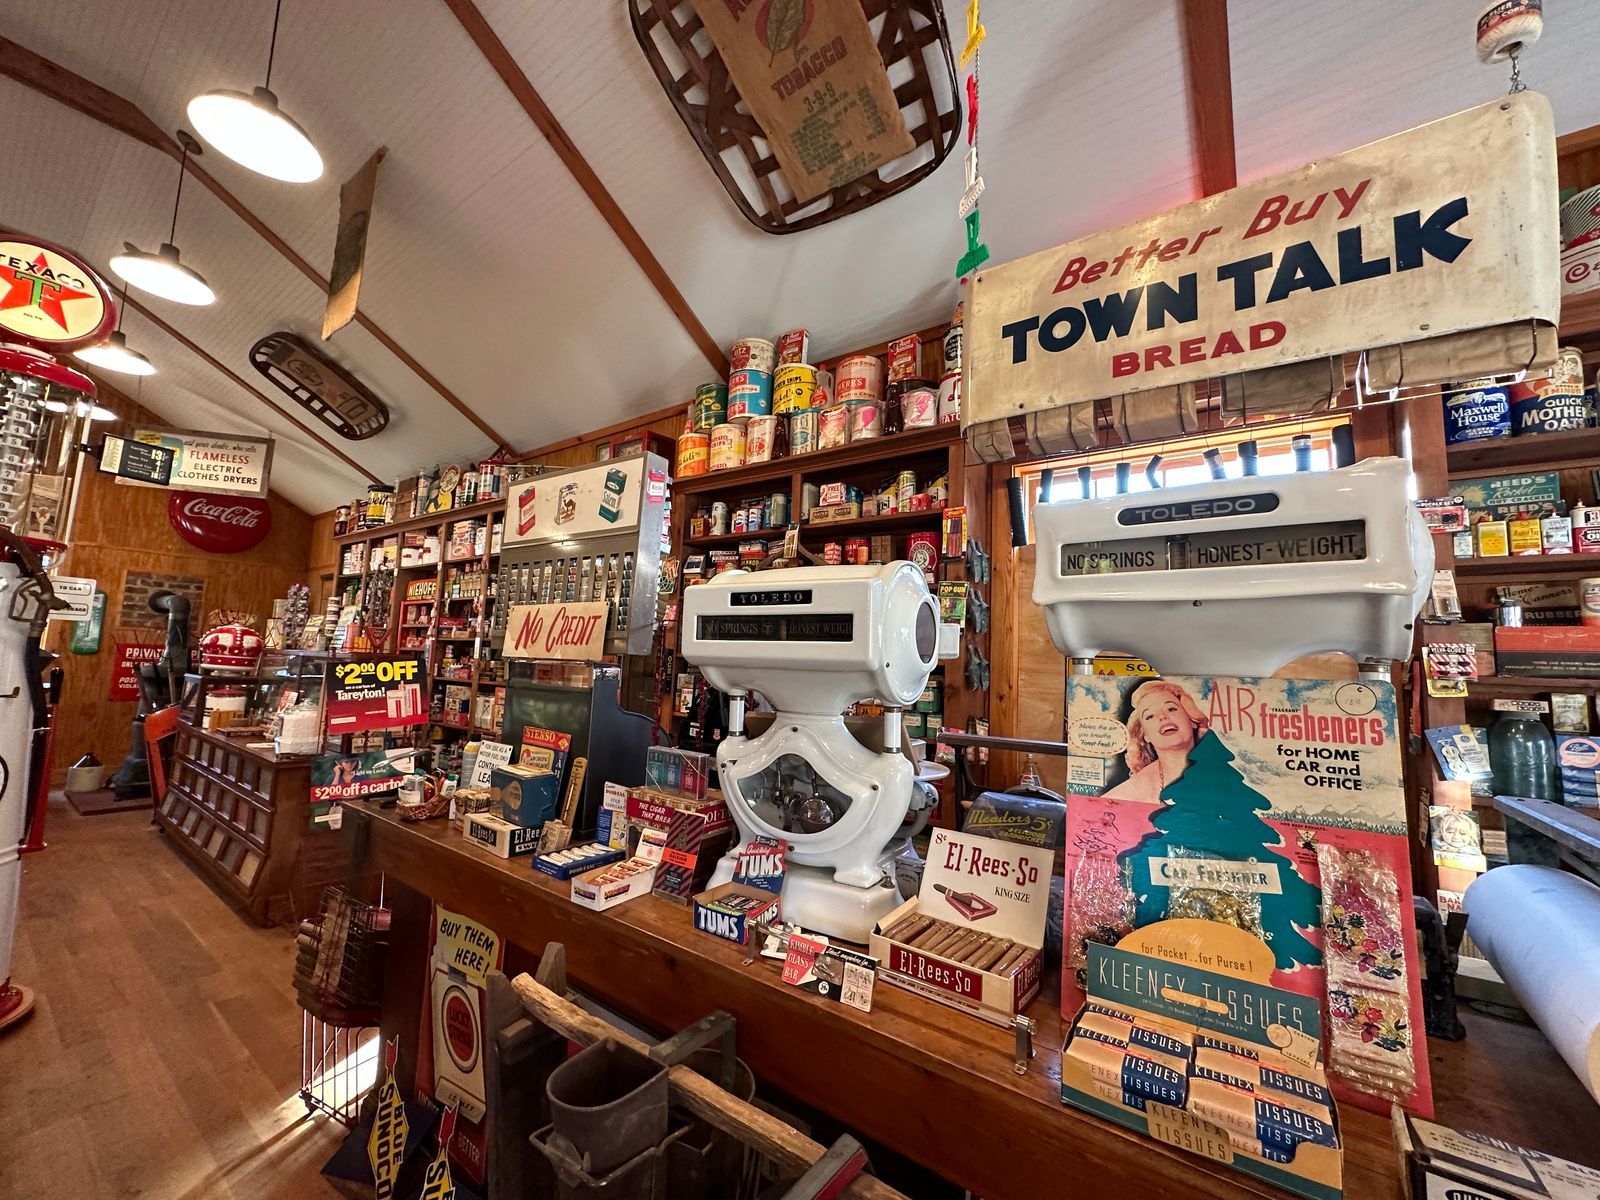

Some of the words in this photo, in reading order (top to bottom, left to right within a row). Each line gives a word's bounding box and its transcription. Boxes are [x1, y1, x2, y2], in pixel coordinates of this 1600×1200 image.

[771, 36, 847, 101] TOBACCO
[1051, 226, 1223, 294] Better
[1002, 272, 1197, 364] TOWN
[1217, 196, 1473, 311] TALK
[1112, 320, 1287, 378] BREAD
[1451, 402, 1505, 419] Maxwell
[1545, 398, 1582, 407] QUICK
[189, 450, 249, 465] FLAMELESS
[177, 470, 220, 481] CLOTHES
[223, 475, 258, 485] DRYERS
[193, 463, 243, 475] ELECTRIC
[1490, 475, 1546, 489] REED'S
[1135, 498, 1256, 522] TOLEDO
[1090, 551, 1155, 569] SPRINGS
[409, 581, 437, 597] NIEHOFF
[740, 592, 803, 604] TOLEDO
[377, 660, 419, 682] OFF
[335, 687, 386, 701] Tareyton!
[1208, 678, 1257, 737] AIR
[1259, 702, 1384, 746] fresheners
[524, 726, 557, 743] STENSO
[1277, 744, 1302, 757] for
[1305, 747, 1360, 761] HOME
[1285, 759, 1321, 772] CAR
[1325, 764, 1361, 776] and
[478, 772, 491, 783] LEA
[1304, 774, 1363, 791] OFFICE
[343, 782, 361, 797] off
[361, 784, 369, 794] a
[639, 802, 649, 811] THE
[650, 805, 666, 814] CIGAR
[641, 810, 654, 819] THAT
[655, 813, 671, 824] BREA
[968, 809, 1031, 825] Meadors
[739, 853, 784, 879] TUMS
[994, 886, 1013, 900] KING
[1013, 889, 1031, 904] SIZE
[697, 906, 739, 942] TUMS
[440, 918, 461, 939] BUY
[464, 925, 495, 956] THEM
[1141, 943, 1153, 954] for
[787, 952, 809, 968] GLASS
[784, 966, 799, 981] BAR
[1088, 1003, 1134, 1021] KLEENEX
[1079, 1028, 1128, 1048] KLEENEX
[1131, 1027, 1182, 1053] TISSUES
[1204, 1037, 1258, 1059] KLEENEX
[1091, 1064, 1120, 1081] ENEX
[1125, 1055, 1179, 1084] TISSUES
[1194, 1066, 1253, 1090] KLEENEX
[1123, 1074, 1176, 1101] TISSUES
[1261, 1068, 1323, 1100] TISSUES
[1151, 1103, 1222, 1138] KLEENEX
[1256, 1100, 1323, 1135] TISSUES
[376, 1082, 395, 1200] SUNOCO
[393, 1103, 404, 1165] BLUE
[1155, 1123, 1226, 1161] TISSUES
